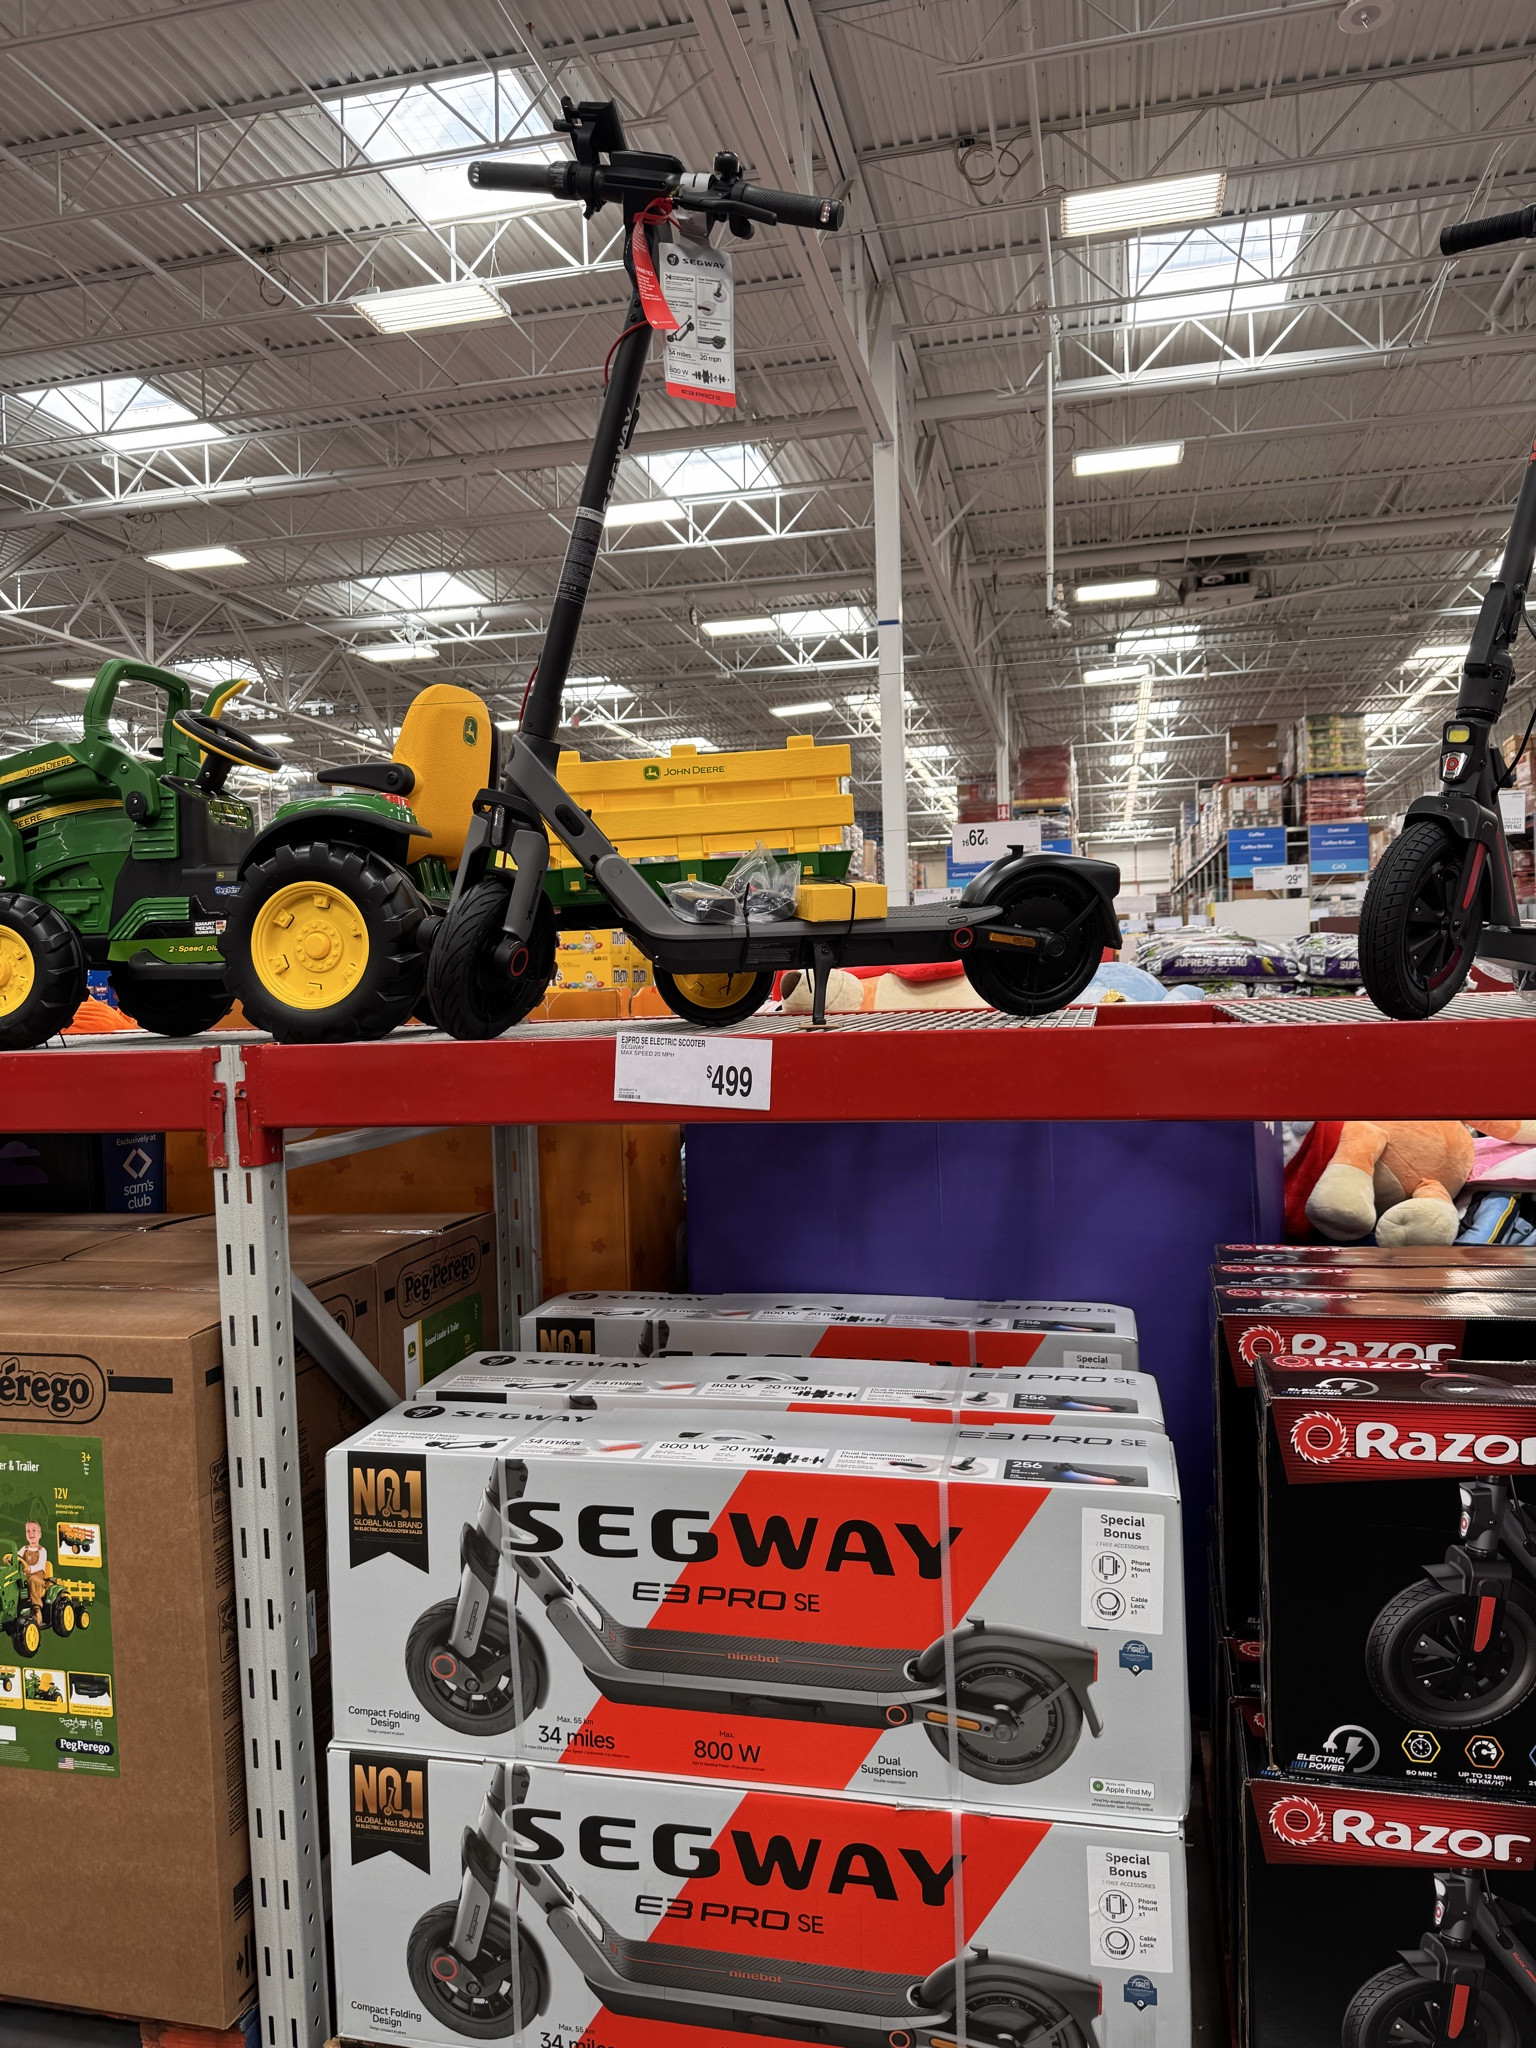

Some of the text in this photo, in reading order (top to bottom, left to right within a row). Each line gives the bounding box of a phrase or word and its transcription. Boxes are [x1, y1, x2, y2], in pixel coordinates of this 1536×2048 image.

[682, 258, 725, 269] SEGWAY
[695, 392, 714, 400] PRO
[25, 757, 72, 777] JOHN DEERE
[664, 766, 725, 776] JOHN DEERE
[169, 944, 204, 953] 2-Speed
[1174, 958, 1248, 968] SUPREME BLEND
[621, 1036, 706, 1048] E3PRO SE ELECTRIC SCOOTER
[706, 1065, 752, 1097] $499
[116, 1135, 150, 1146] Exclusively
[124, 1180, 154, 1196] sam's
[128, 1193, 152, 1210] club
[1253, 1266, 1352, 1274] Razor
[607, 1294, 710, 1302] SEGWAY
[1260, 1289, 1362, 1299] Razor
[522, 1358, 649, 1368] SEGWAY
[1076, 1354, 1108, 1365] Special
[1314, 1357, 1443, 1371] Razor
[969, 1372, 1137, 1386] E3 PRO SE
[451, 1410, 593, 1423] SEGWAY
[959, 1430, 1148, 1448] E3 PRO SE
[659, 1442, 689, 1450] 800
[741, 1446, 774, 1454] mph
[81, 1452, 91, 1463] 3+
[9, 1460, 40, 1472] & Trailer
[1012, 1461, 1042, 1469] 256
[54, 1487, 68, 1500] 12V
[354, 1518, 423, 1529] GLOBAL No.1 BRAND
[1100, 1514, 1145, 1528] Special
[504, 1500, 964, 1580] SEGWAY
[1104, 1528, 1142, 1540] Bonus
[1131, 1566, 1151, 1574] Mount
[632, 1581, 820, 1614] E3 PRO SE
[727, 1652, 781, 1664] ninebot
[348, 1705, 420, 1722] Compact Folding
[370, 1717, 400, 1730] Design
[556, 1714, 594, 1726] Max. 55 km
[538, 1724, 616, 1750] 34 miles
[719, 1730, 735, 1739] Max.
[60, 1738, 110, 1755] PegPerego
[693, 1739, 761, 1763] 800 W
[877, 1754, 901, 1766] Dual
[1296, 1752, 1345, 1764] ELECTRIC
[861, 1764, 918, 1778] Suspension
[1308, 1762, 1346, 1772] POWER
[1466, 1777, 1504, 1787] (19 KM/H)
[1494, 1774, 1512, 1782] MPH
[1105, 1786, 1124, 1794] Apple
[1141, 1789, 1152, 1797] My
[355, 1815, 383, 1826] GLOBAL
[399, 1820, 424, 1830] BRAND
[381, 1826, 410, 1834] KICKSCOOTER
[1332, 1808, 1532, 1861] Razor
[504, 1808, 968, 1907] SEGWAY
[1105, 1852, 1150, 1866] Special
[1109, 1866, 1148, 1878] Bonus
[1119, 1881, 1156, 1889] ACCESSORIES
[635, 1894, 824, 1935] E3 PRO SE
[729, 1970, 783, 1984] ninebot
[351, 2000, 422, 2022] Compact Folding
[372, 2014, 402, 2028] Design
[557, 2023, 573, 2032] Max.
[574, 2025, 584, 2033] 55
[540, 2031, 614, 2048] 34 miles
